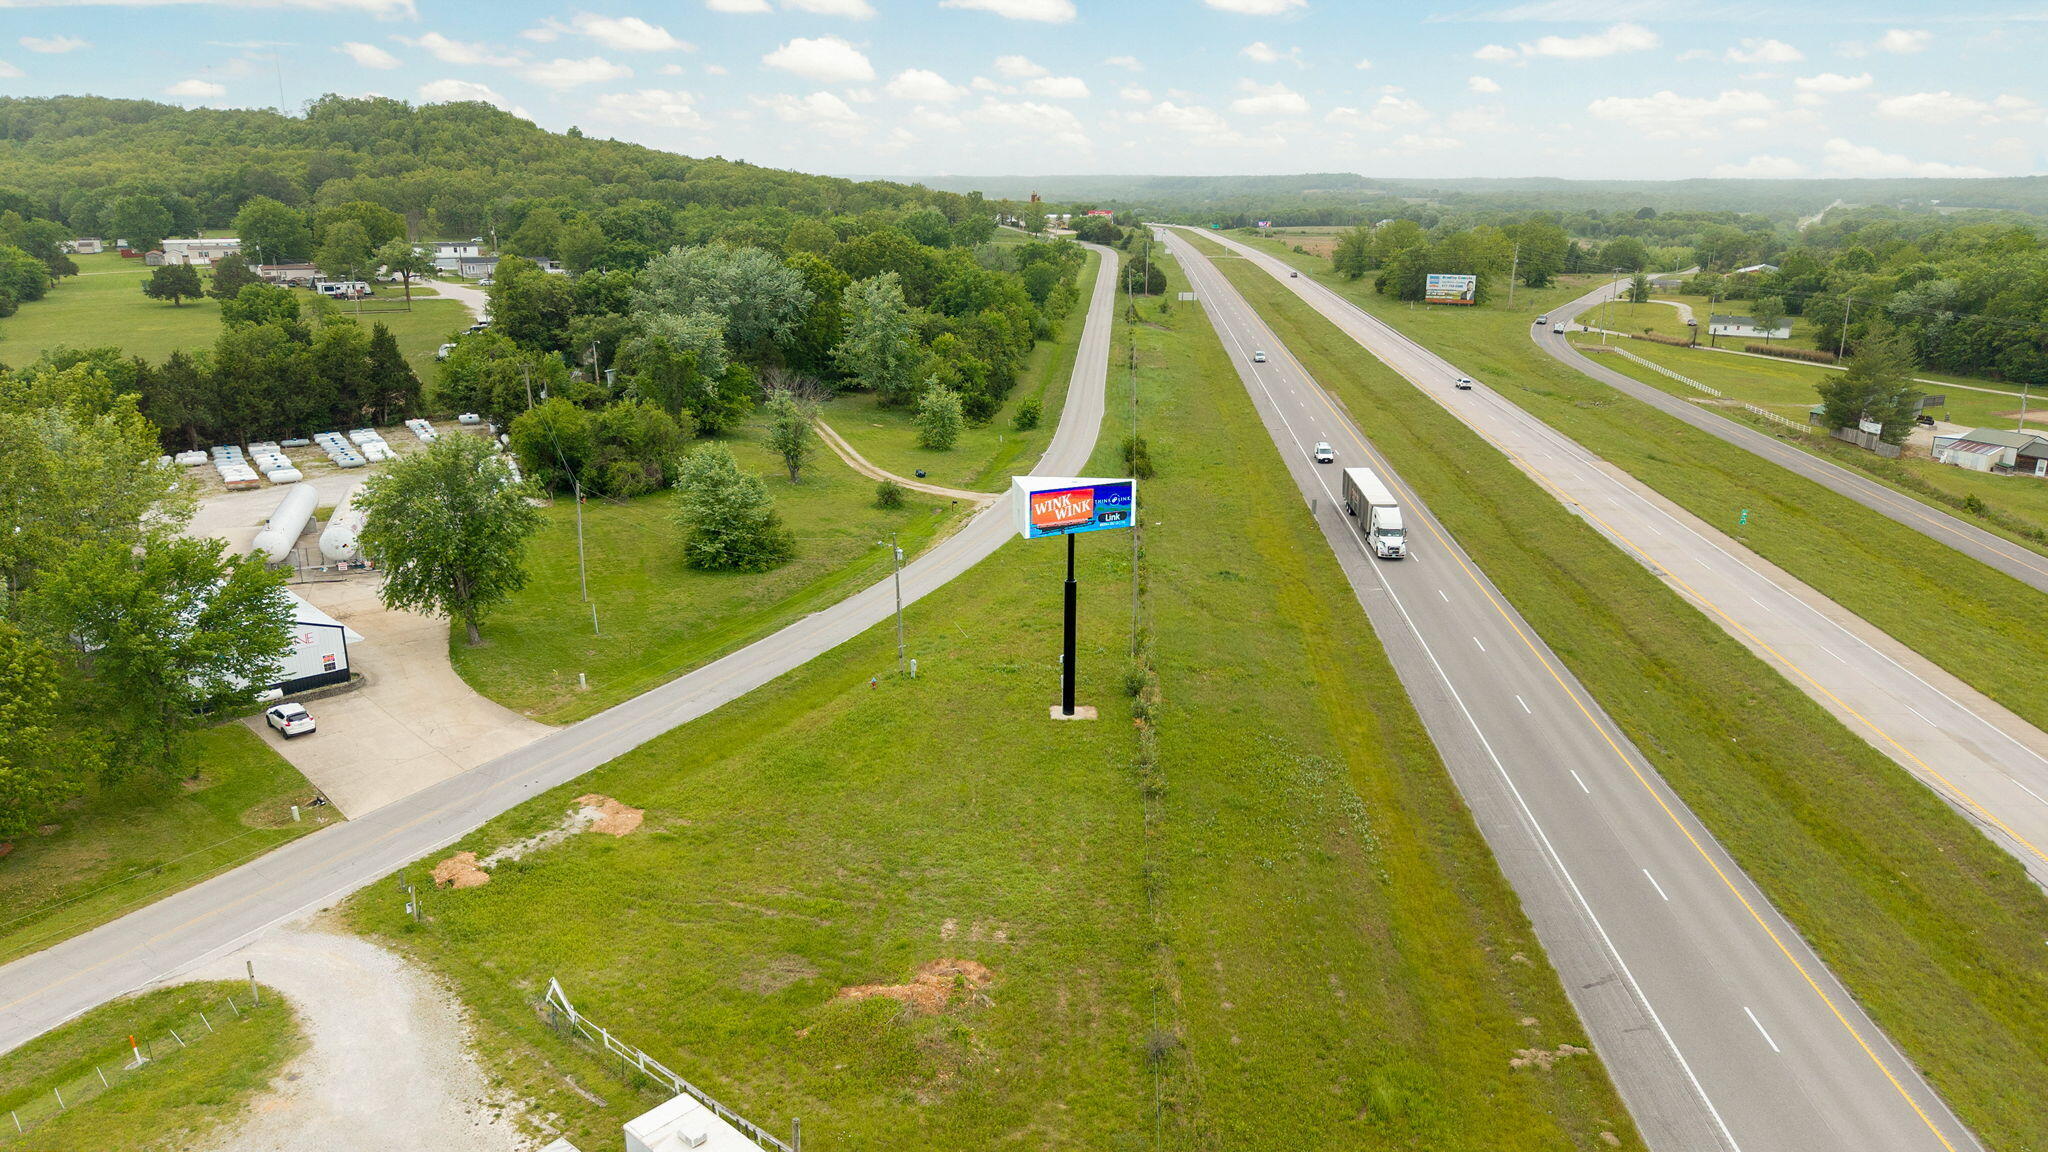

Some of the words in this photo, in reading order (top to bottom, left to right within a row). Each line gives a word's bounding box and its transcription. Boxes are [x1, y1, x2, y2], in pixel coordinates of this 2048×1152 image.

[1034, 493, 1071, 515] WINK
[1055, 499, 1091, 520] WINK
[1105, 513, 1120, 522] Link
